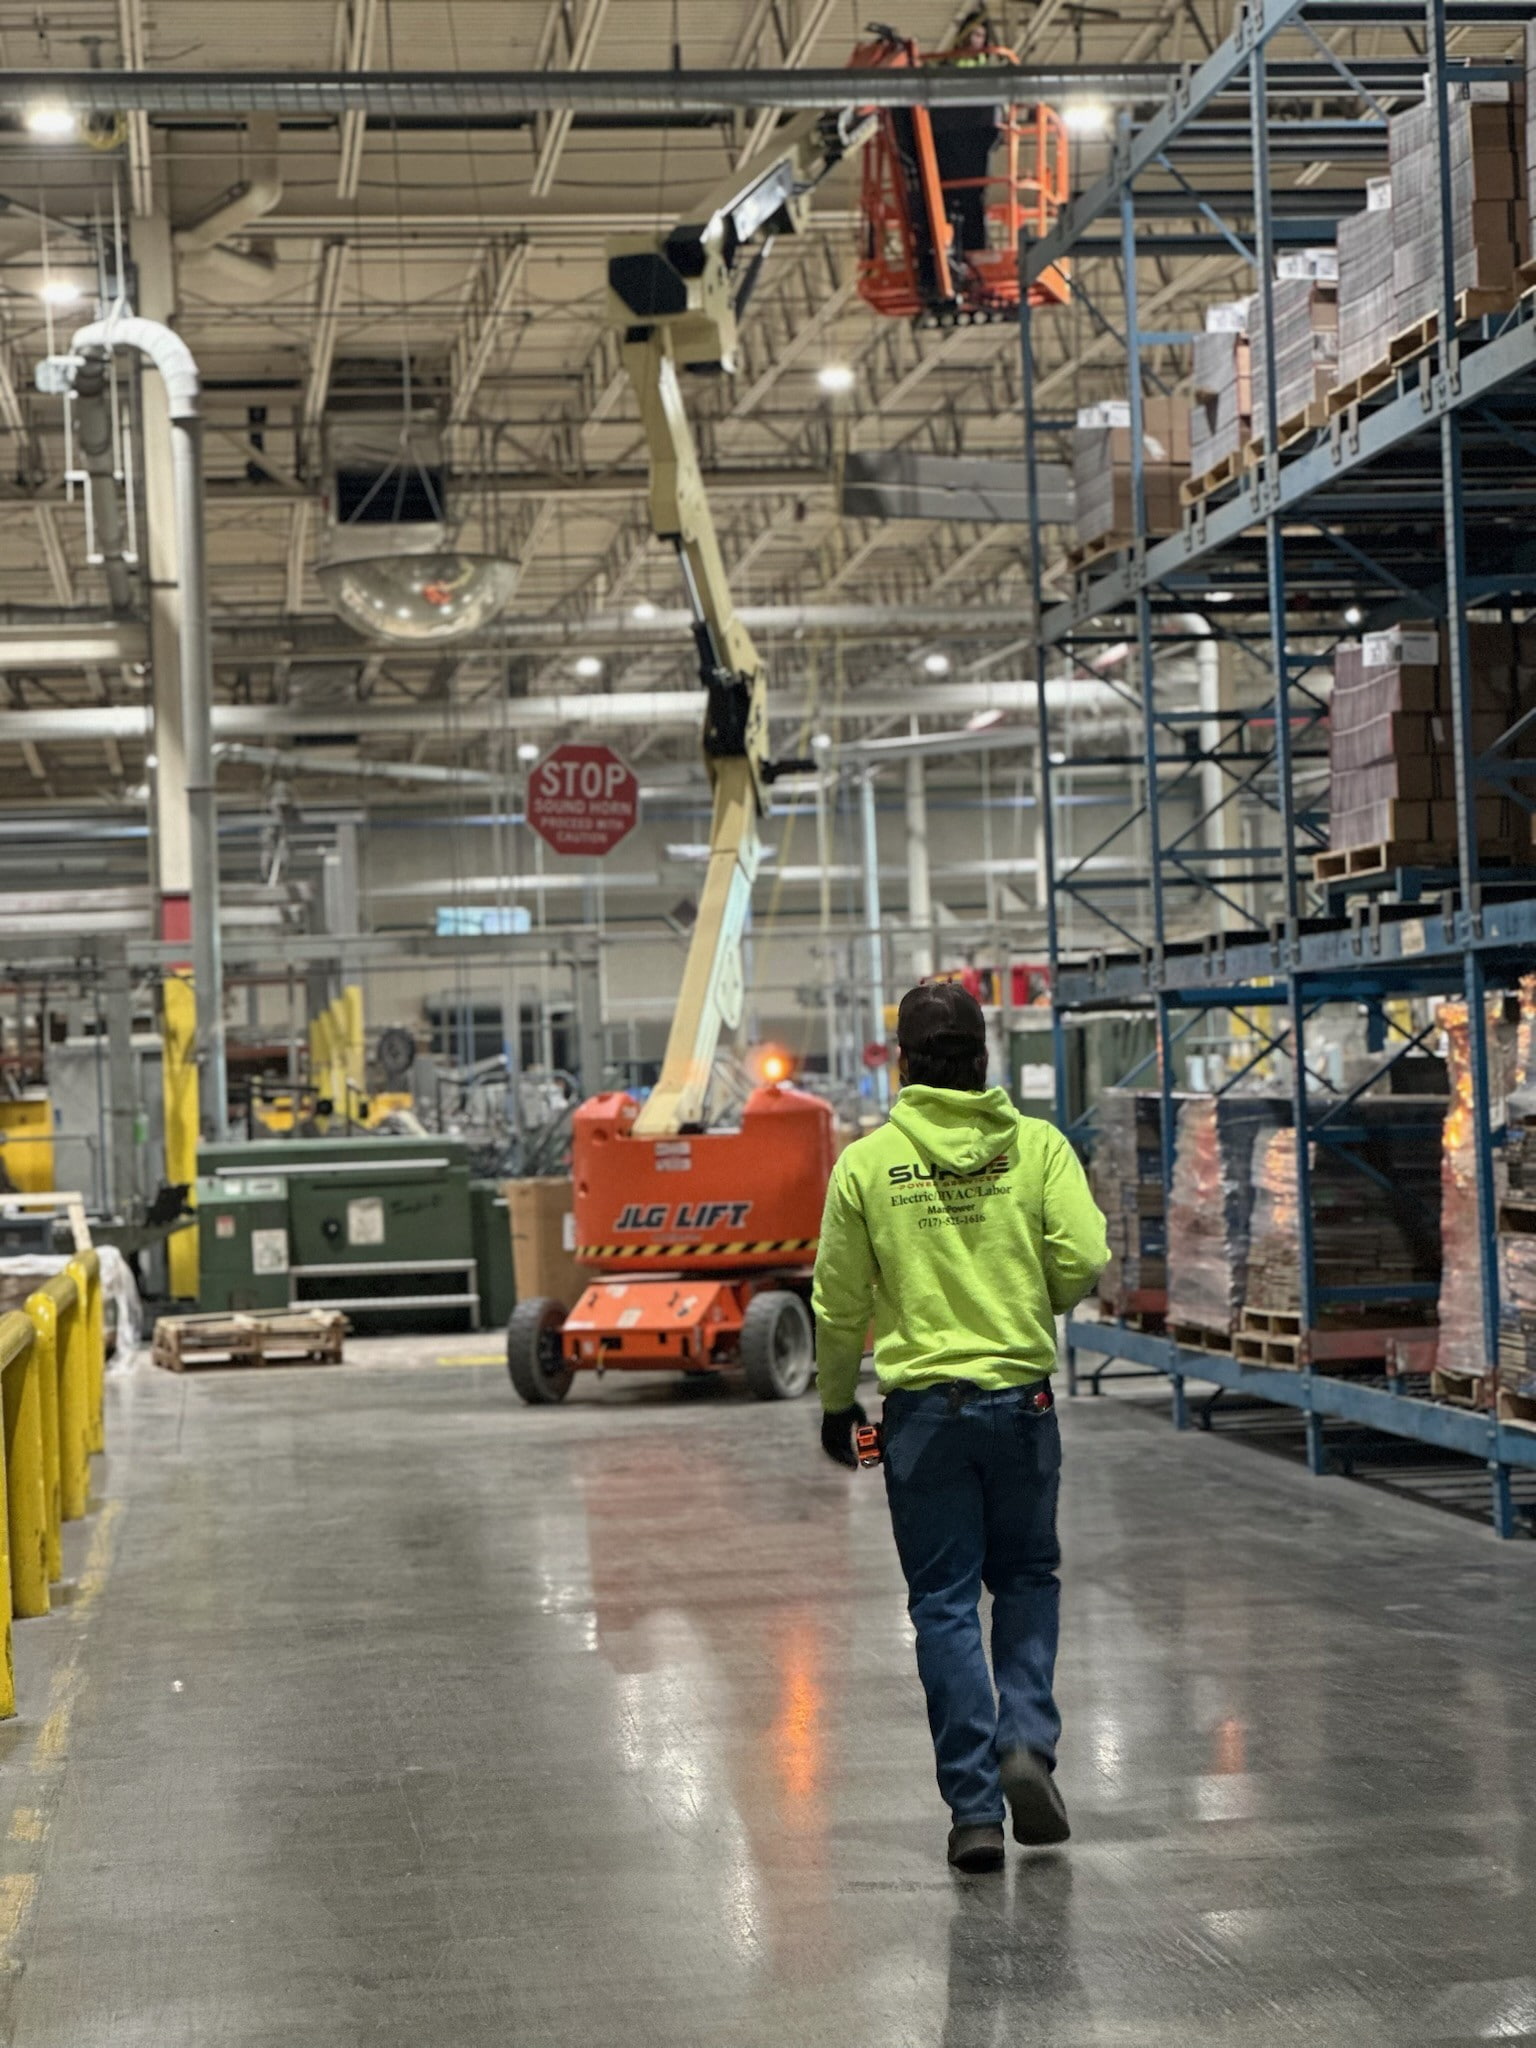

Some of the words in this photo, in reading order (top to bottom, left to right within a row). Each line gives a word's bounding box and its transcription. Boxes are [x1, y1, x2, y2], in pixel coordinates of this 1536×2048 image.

[539, 761, 627, 798] STOP
[534, 798, 586, 814] SOUND
[588, 801, 632, 816] HORN
[615, 1204, 669, 1231] JLG
[674, 1202, 751, 1230] LIFT
